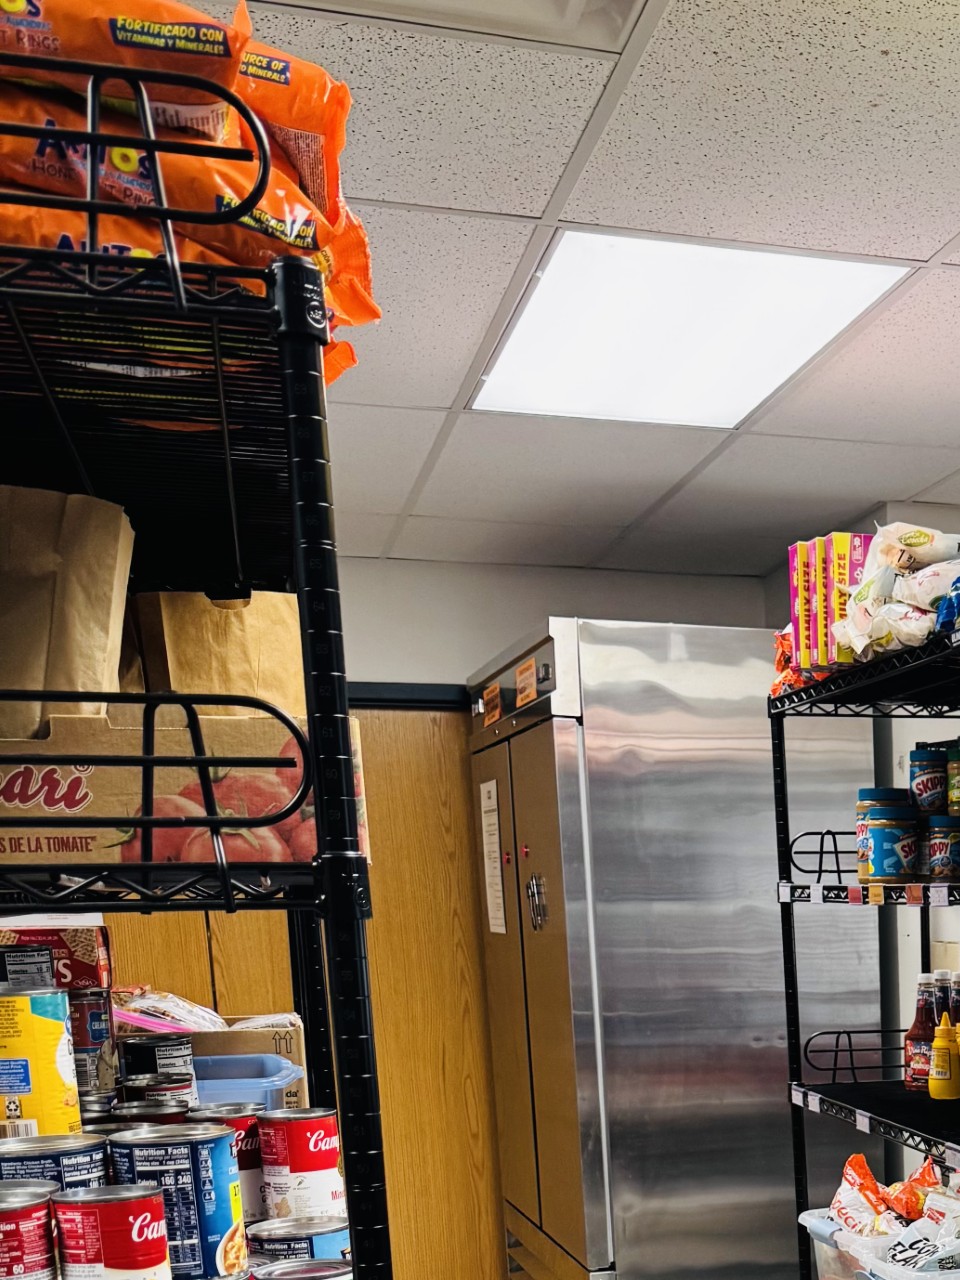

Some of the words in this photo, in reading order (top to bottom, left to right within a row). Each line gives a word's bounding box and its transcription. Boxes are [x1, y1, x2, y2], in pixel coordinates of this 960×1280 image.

[117, 16, 196, 39] FORTIFICADO
[199, 29, 224, 42] CON
[117, 31, 165, 48] VITAMINAS
[167, 39, 174, 49] Y
[175, 40, 224, 55] MINERALES
[803, 561, 811, 593] SIZE
[837, 553, 847, 586] SIZE
[9, 836, 25, 853] DE
[27, 836, 42, 853] LA
[135, 1147, 166, 1156] Nutrition
[167, 1147, 189, 1155] Facts
[160, 1175, 175, 1185] 160
[177, 1175, 192, 1185] 340
[264, 1242, 288, 1250] Nutrition
[12, 1263, 24, 1275] 60
